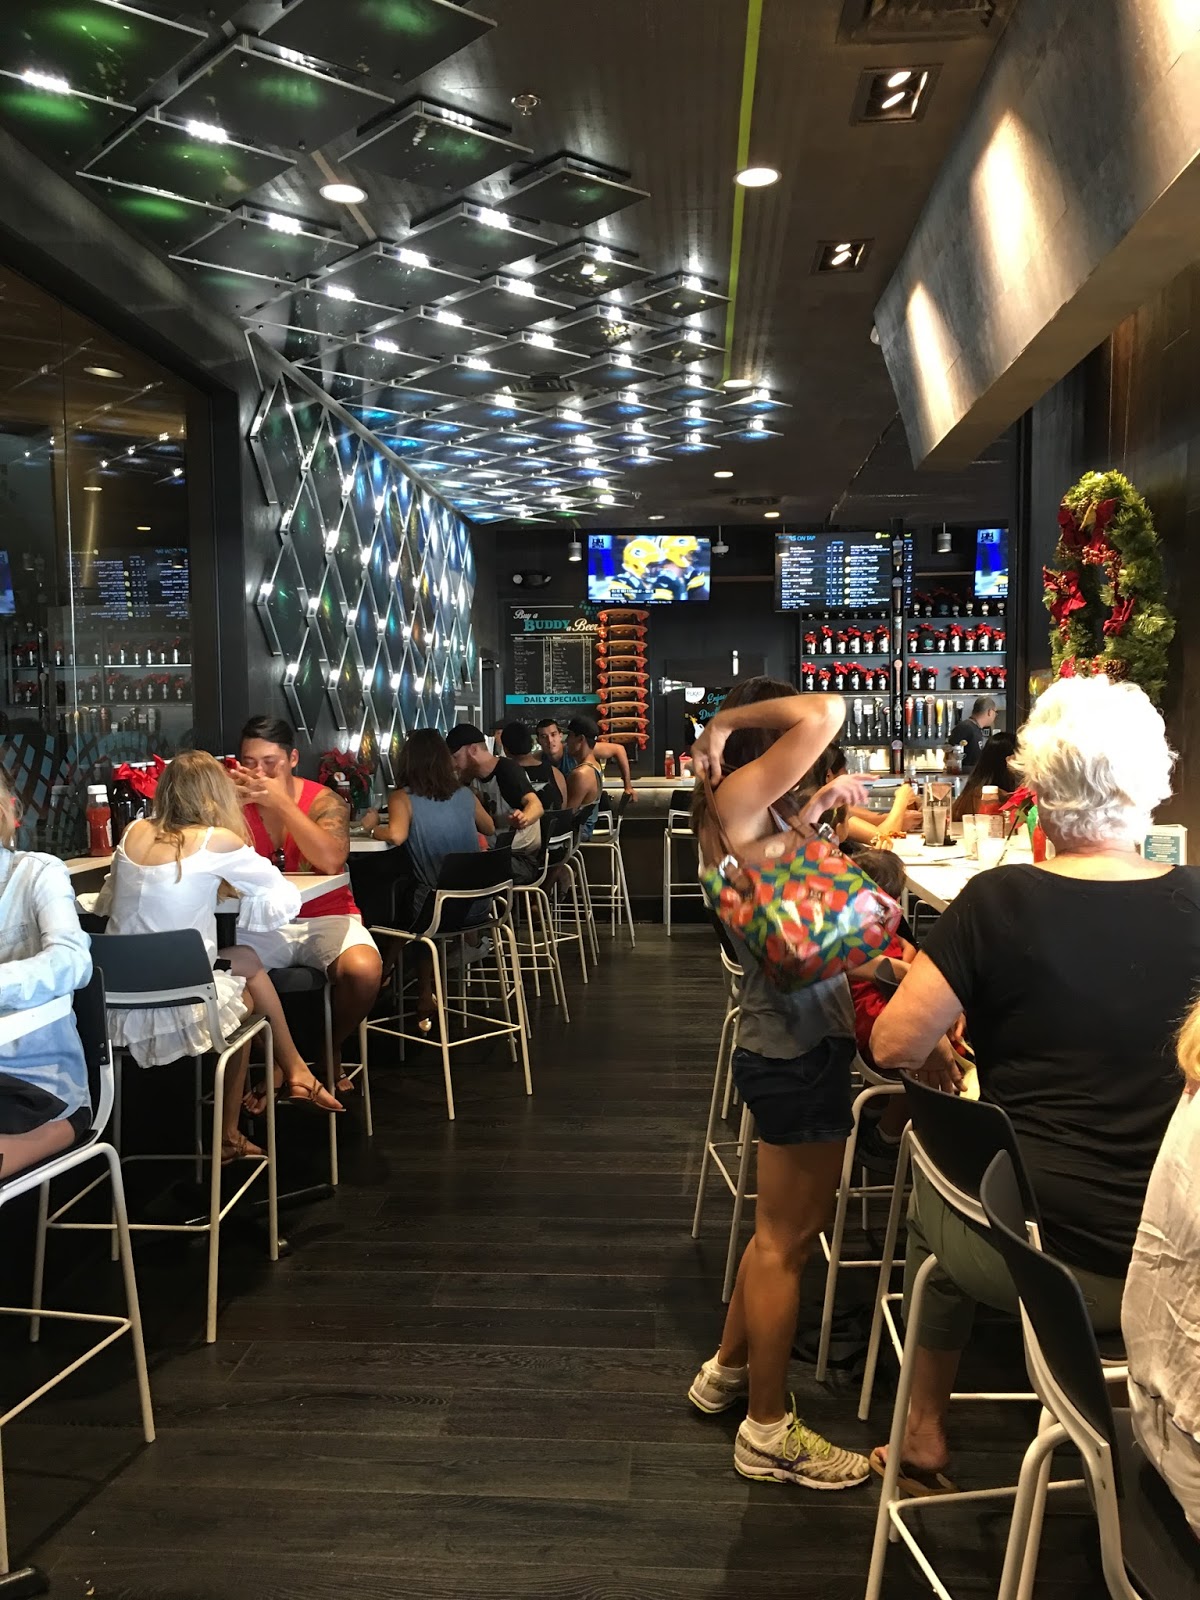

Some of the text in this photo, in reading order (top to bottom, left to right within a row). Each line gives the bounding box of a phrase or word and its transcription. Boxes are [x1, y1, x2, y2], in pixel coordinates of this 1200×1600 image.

[513, 609, 532, 620] Buy
[523, 619, 570, 632] BUDDY
[572, 618, 598, 632] Beer
